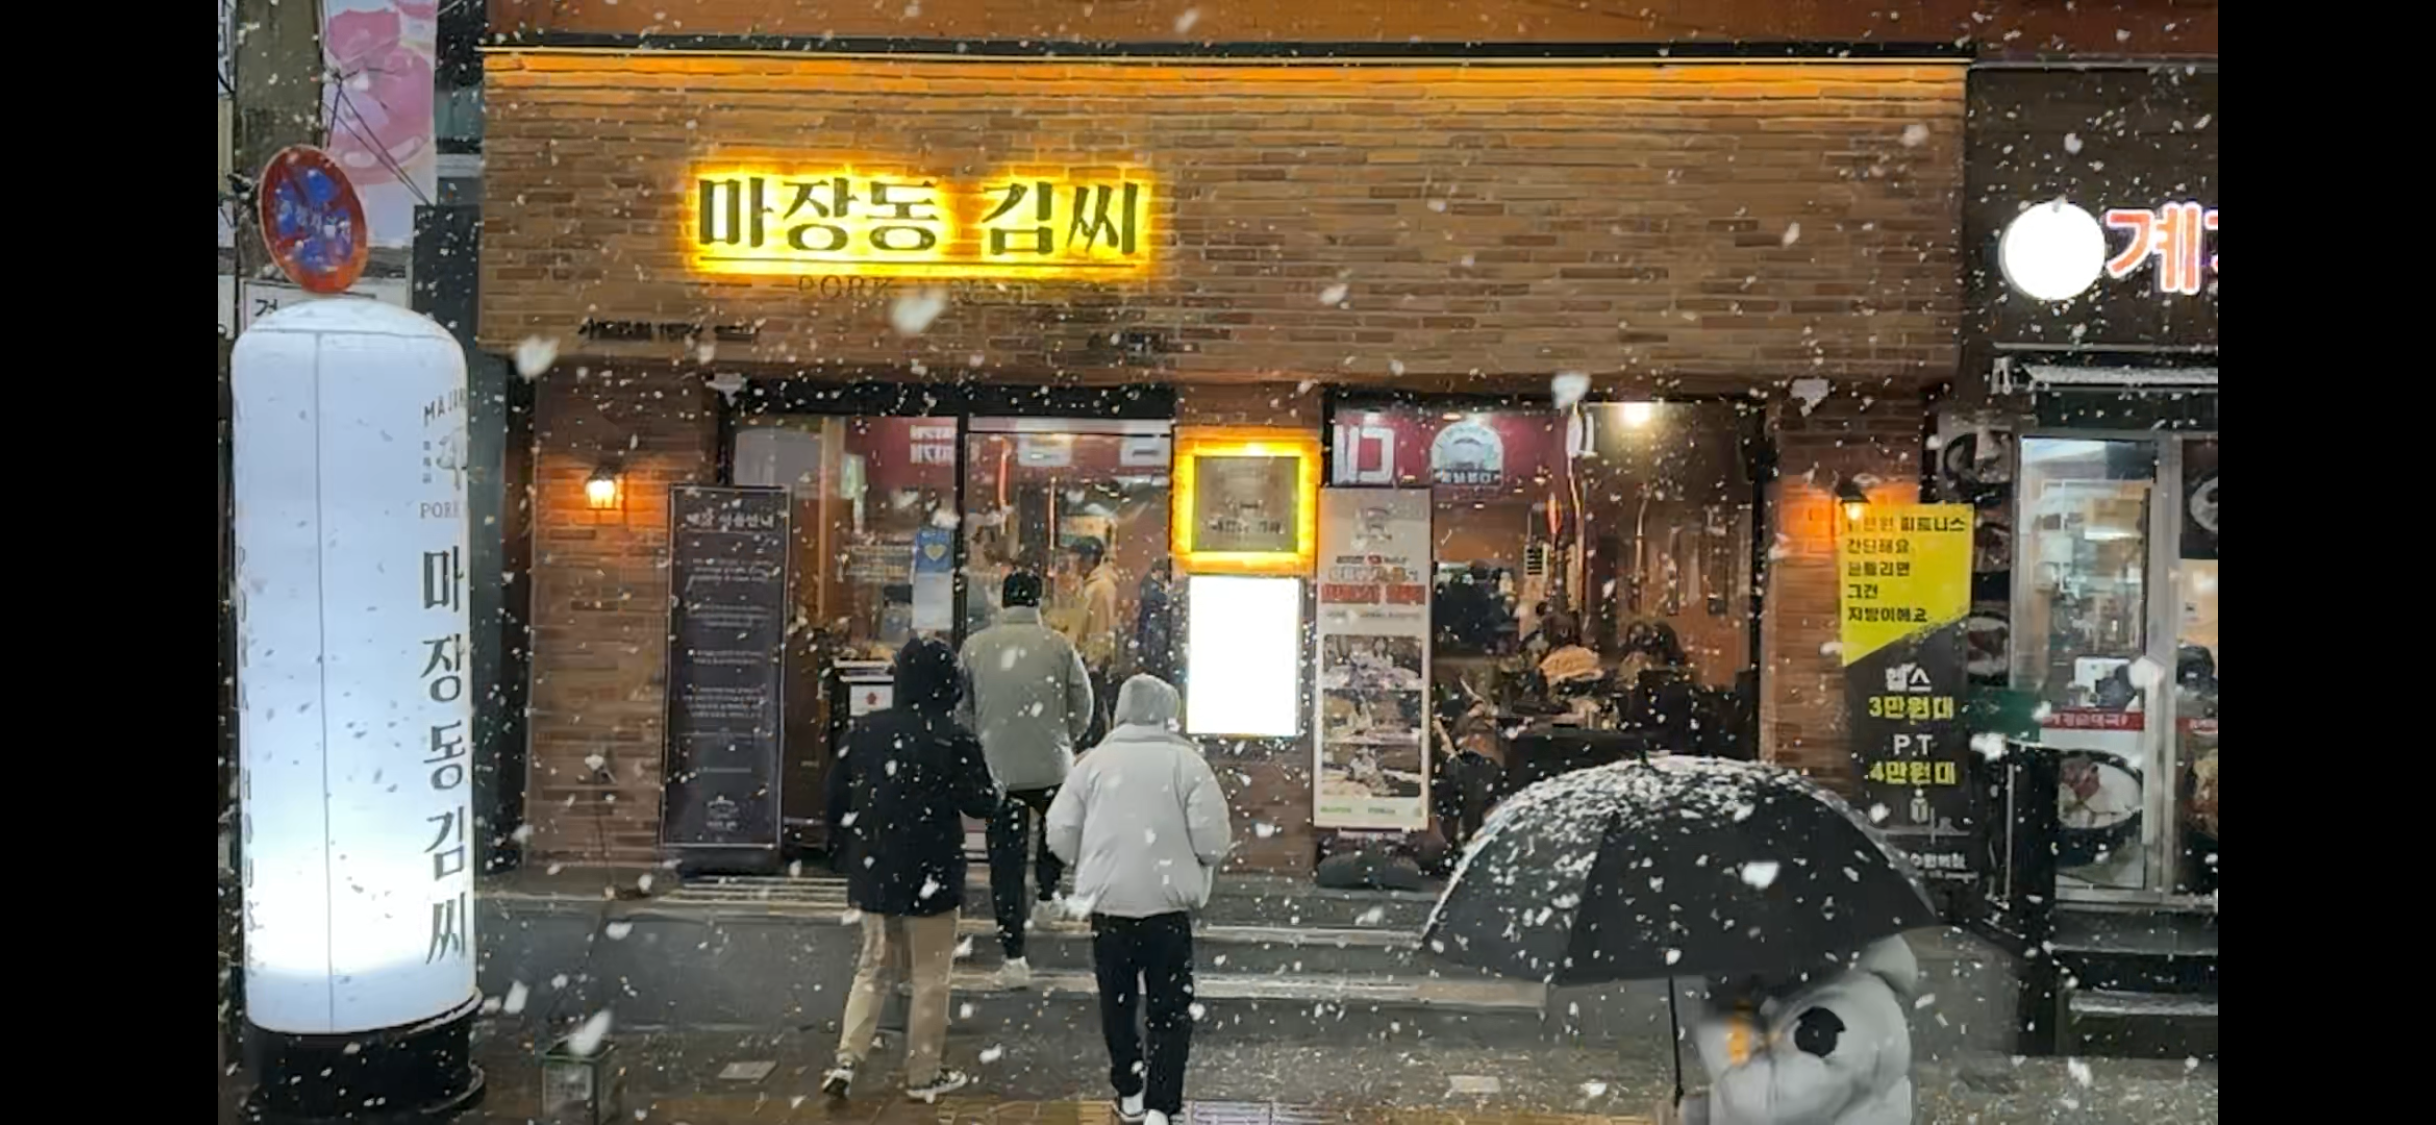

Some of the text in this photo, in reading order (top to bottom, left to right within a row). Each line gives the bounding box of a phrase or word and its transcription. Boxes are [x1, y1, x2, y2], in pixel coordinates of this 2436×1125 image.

[699, 177, 1138, 256] 마장동 김씨
[1868, 696, 1954, 719] 3만원대
[1870, 761, 1956, 784] 4만원대
